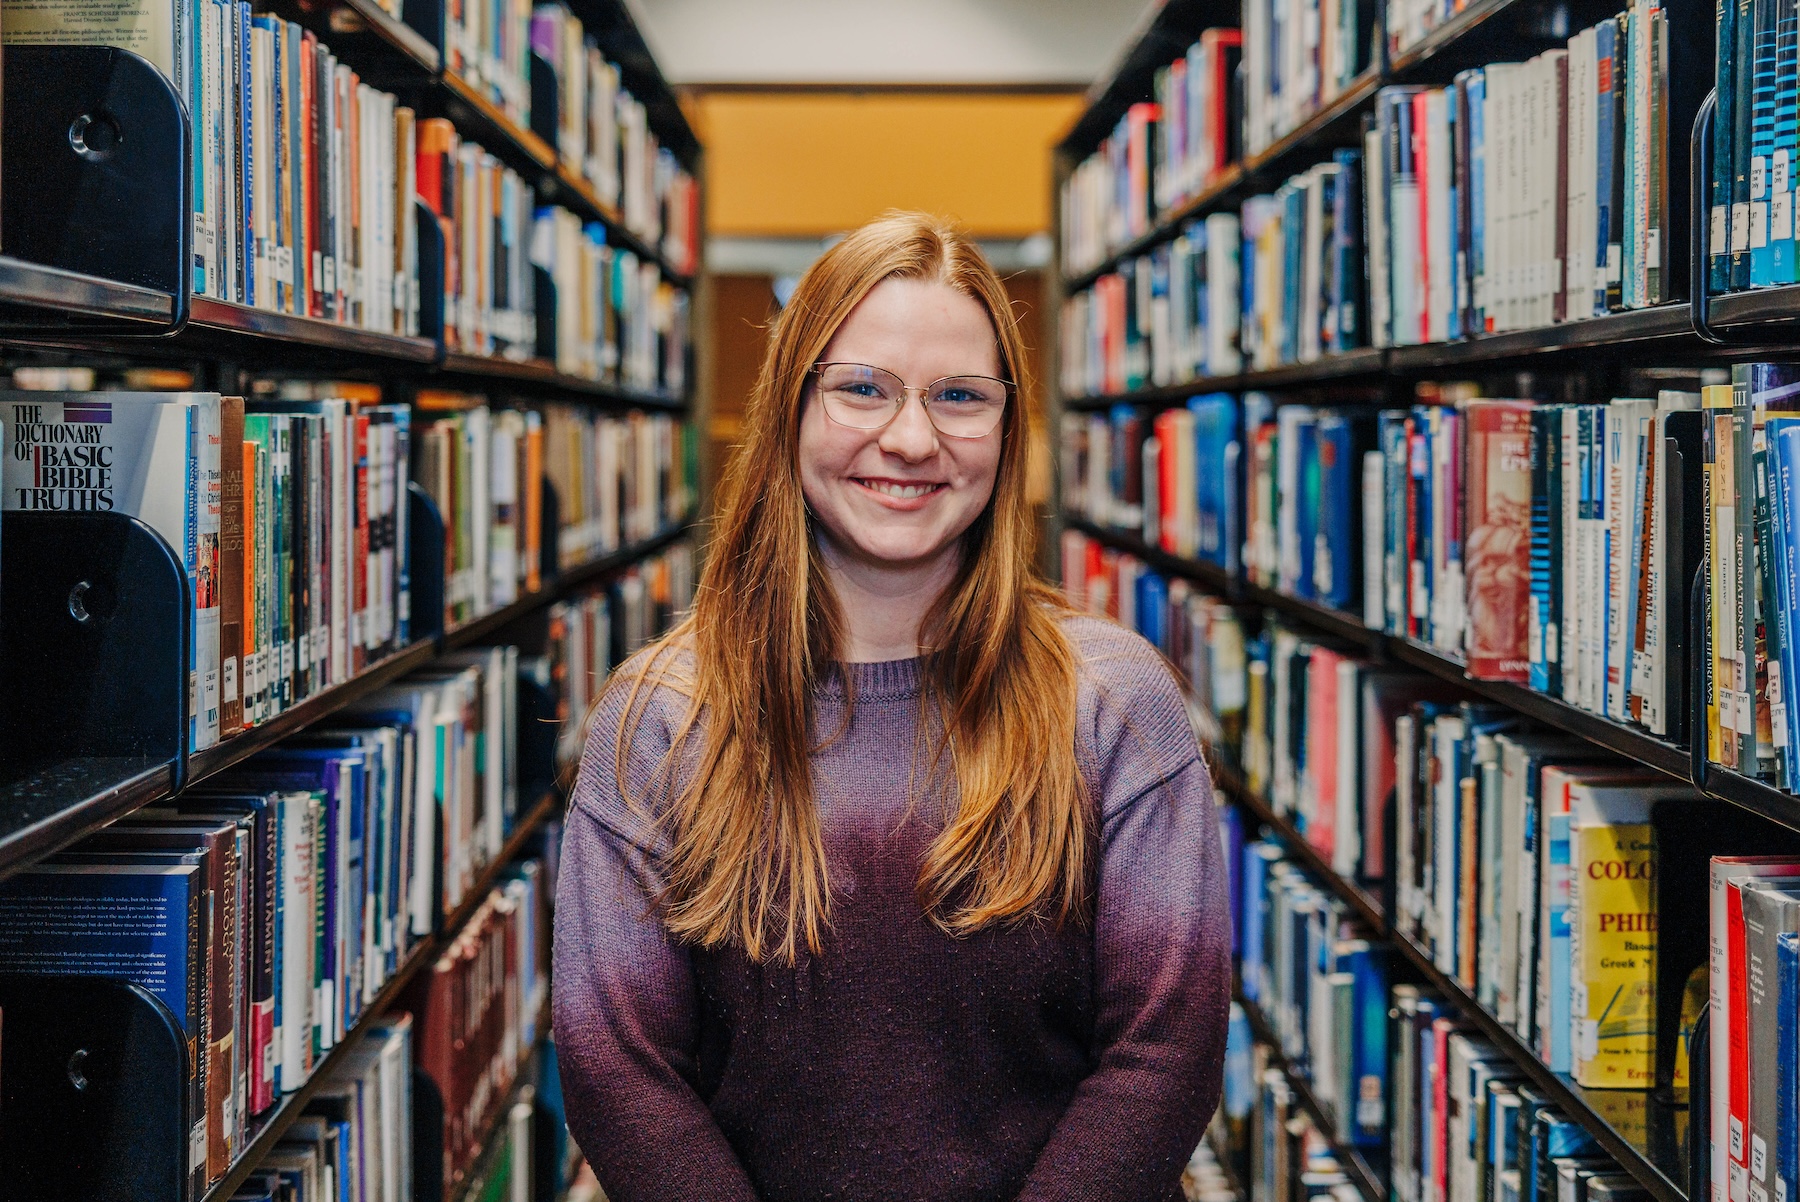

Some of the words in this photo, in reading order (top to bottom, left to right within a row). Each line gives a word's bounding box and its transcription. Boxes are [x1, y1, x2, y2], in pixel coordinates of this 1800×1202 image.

[12, 405, 43, 424] THE
[14, 424, 103, 443] DICTIONARY
[14, 442, 34, 461] OF
[41, 445, 113, 467] BASIC
[41, 467, 113, 489] BIBLE
[15, 488, 114, 511] TRUTHS
[1636, 470, 1644, 525] EPHESIANS
[1769, 473, 1780, 534] HEBREWS
[1610, 465, 1622, 559] APPLICATION
[1760, 504, 1766, 516] 15
[1782, 465, 1792, 533] Hebrews
[1788, 546, 1797, 610] Stedman
[1736, 532, 1744, 625] REFORMATION
[1706, 626, 1712, 638] OF
[222, 850, 230, 958] THEOLOGY
[1600, 958, 1636, 968] Greek
[1751, 952, 1762, 964] James,
[1750, 963, 1764, 976] Epistles
[1750, 982, 1760, 992] Peter
[1754, 976, 1764, 986] John,
[1752, 995, 1761, 1006] Jude
